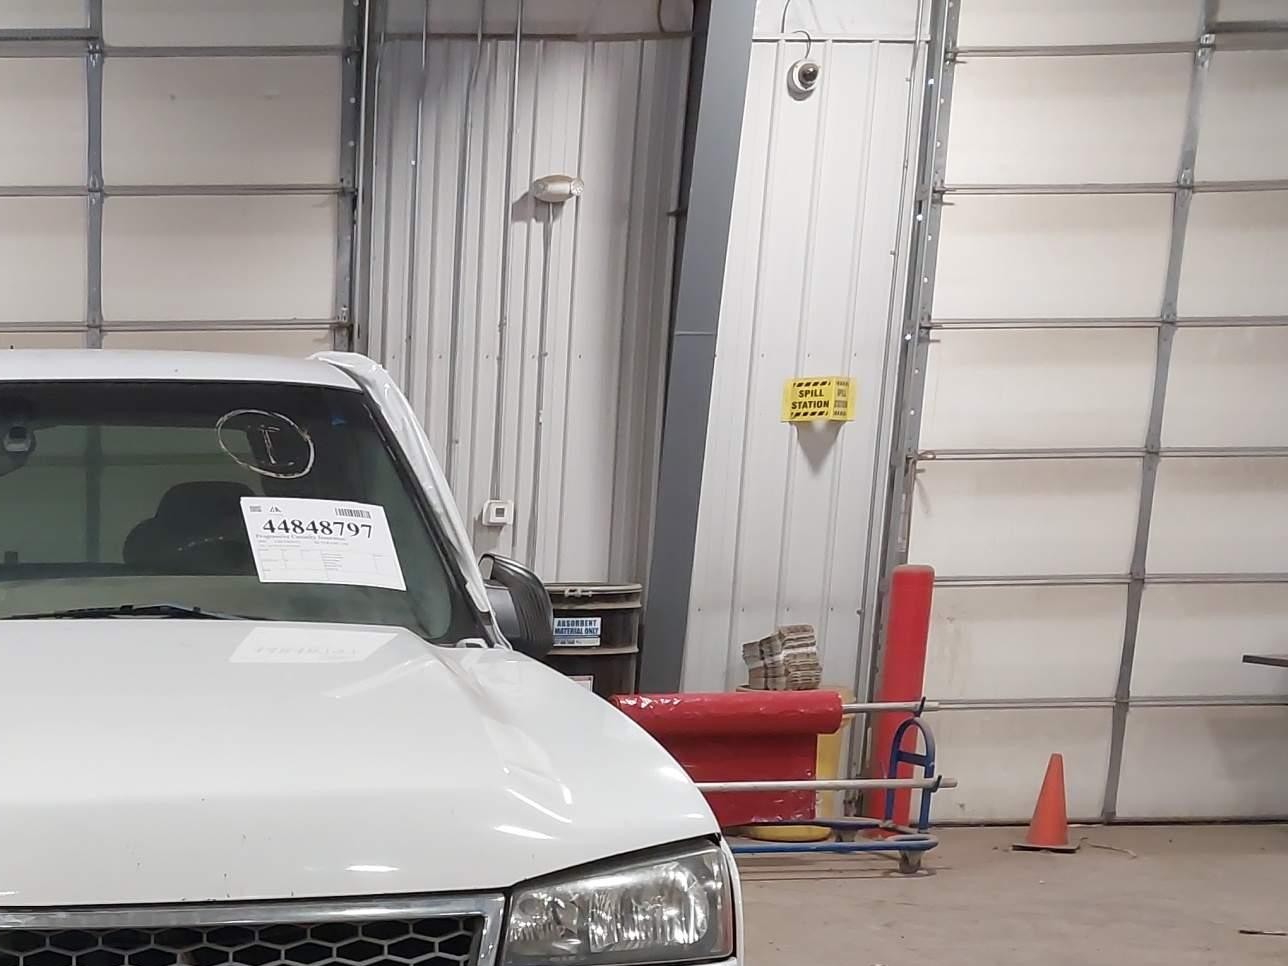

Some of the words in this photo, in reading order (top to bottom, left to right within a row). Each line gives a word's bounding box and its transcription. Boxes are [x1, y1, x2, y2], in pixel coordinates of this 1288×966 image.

[798, 389, 825, 398] SPILL
[791, 400, 830, 409] STATION
[262, 518, 373, 539] 44848797
